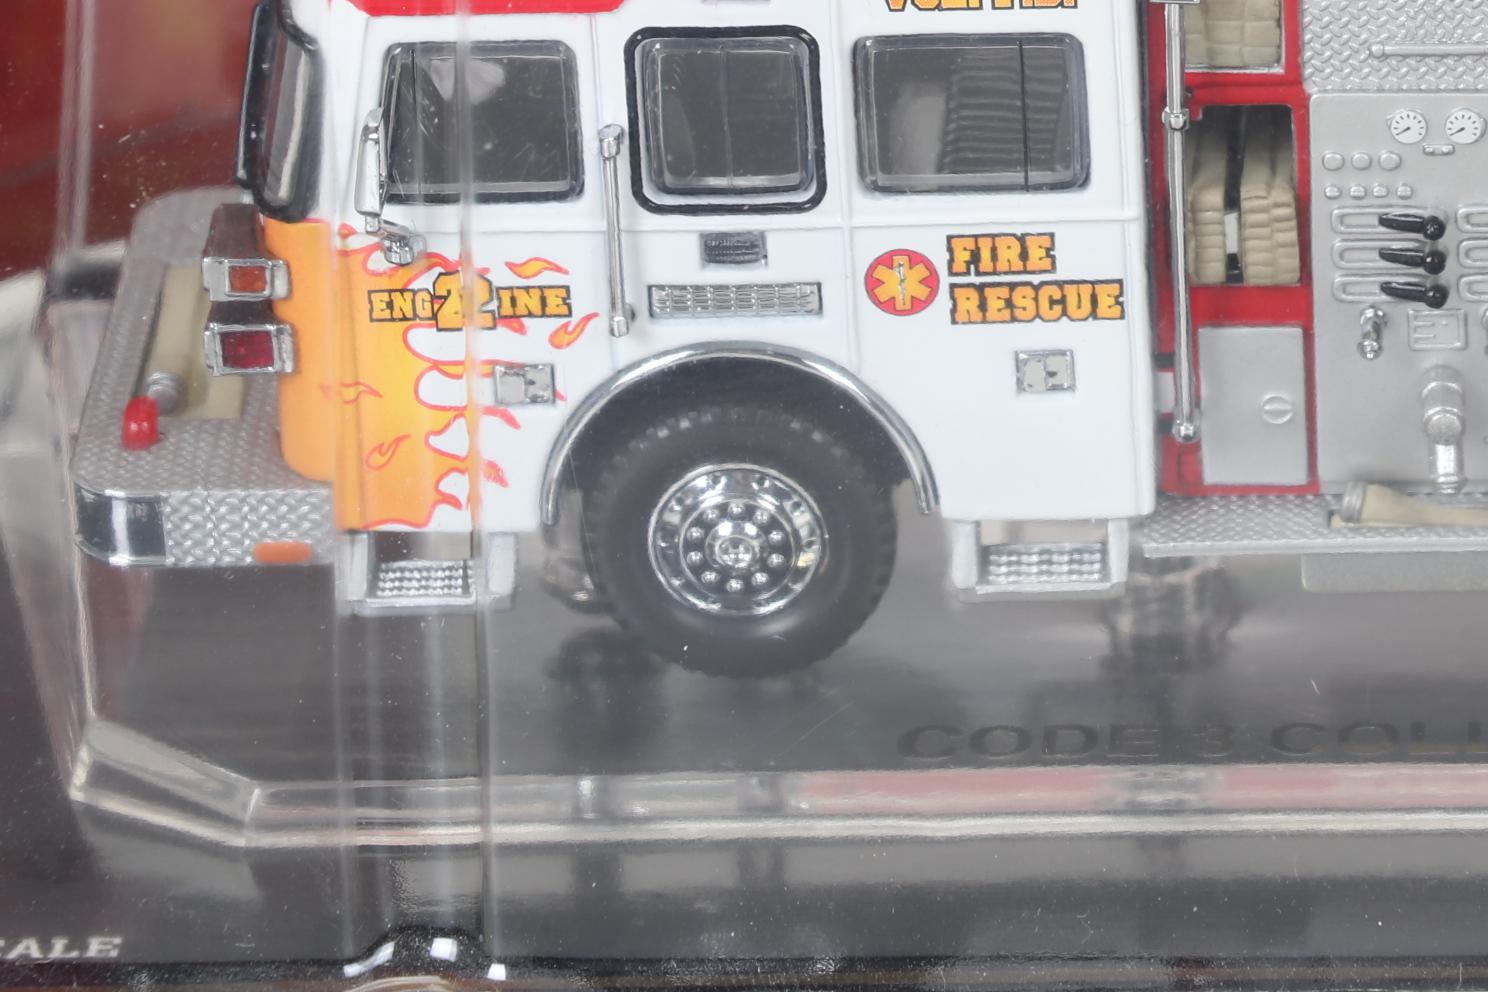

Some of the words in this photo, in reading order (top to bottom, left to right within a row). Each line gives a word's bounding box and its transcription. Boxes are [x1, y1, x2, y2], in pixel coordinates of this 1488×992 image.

[946, 233, 1056, 276] FIRE
[949, 279, 1125, 324] RESCUE
[898, 722, 1160, 758] CODE
[0, 937, 123, 960] ALE
